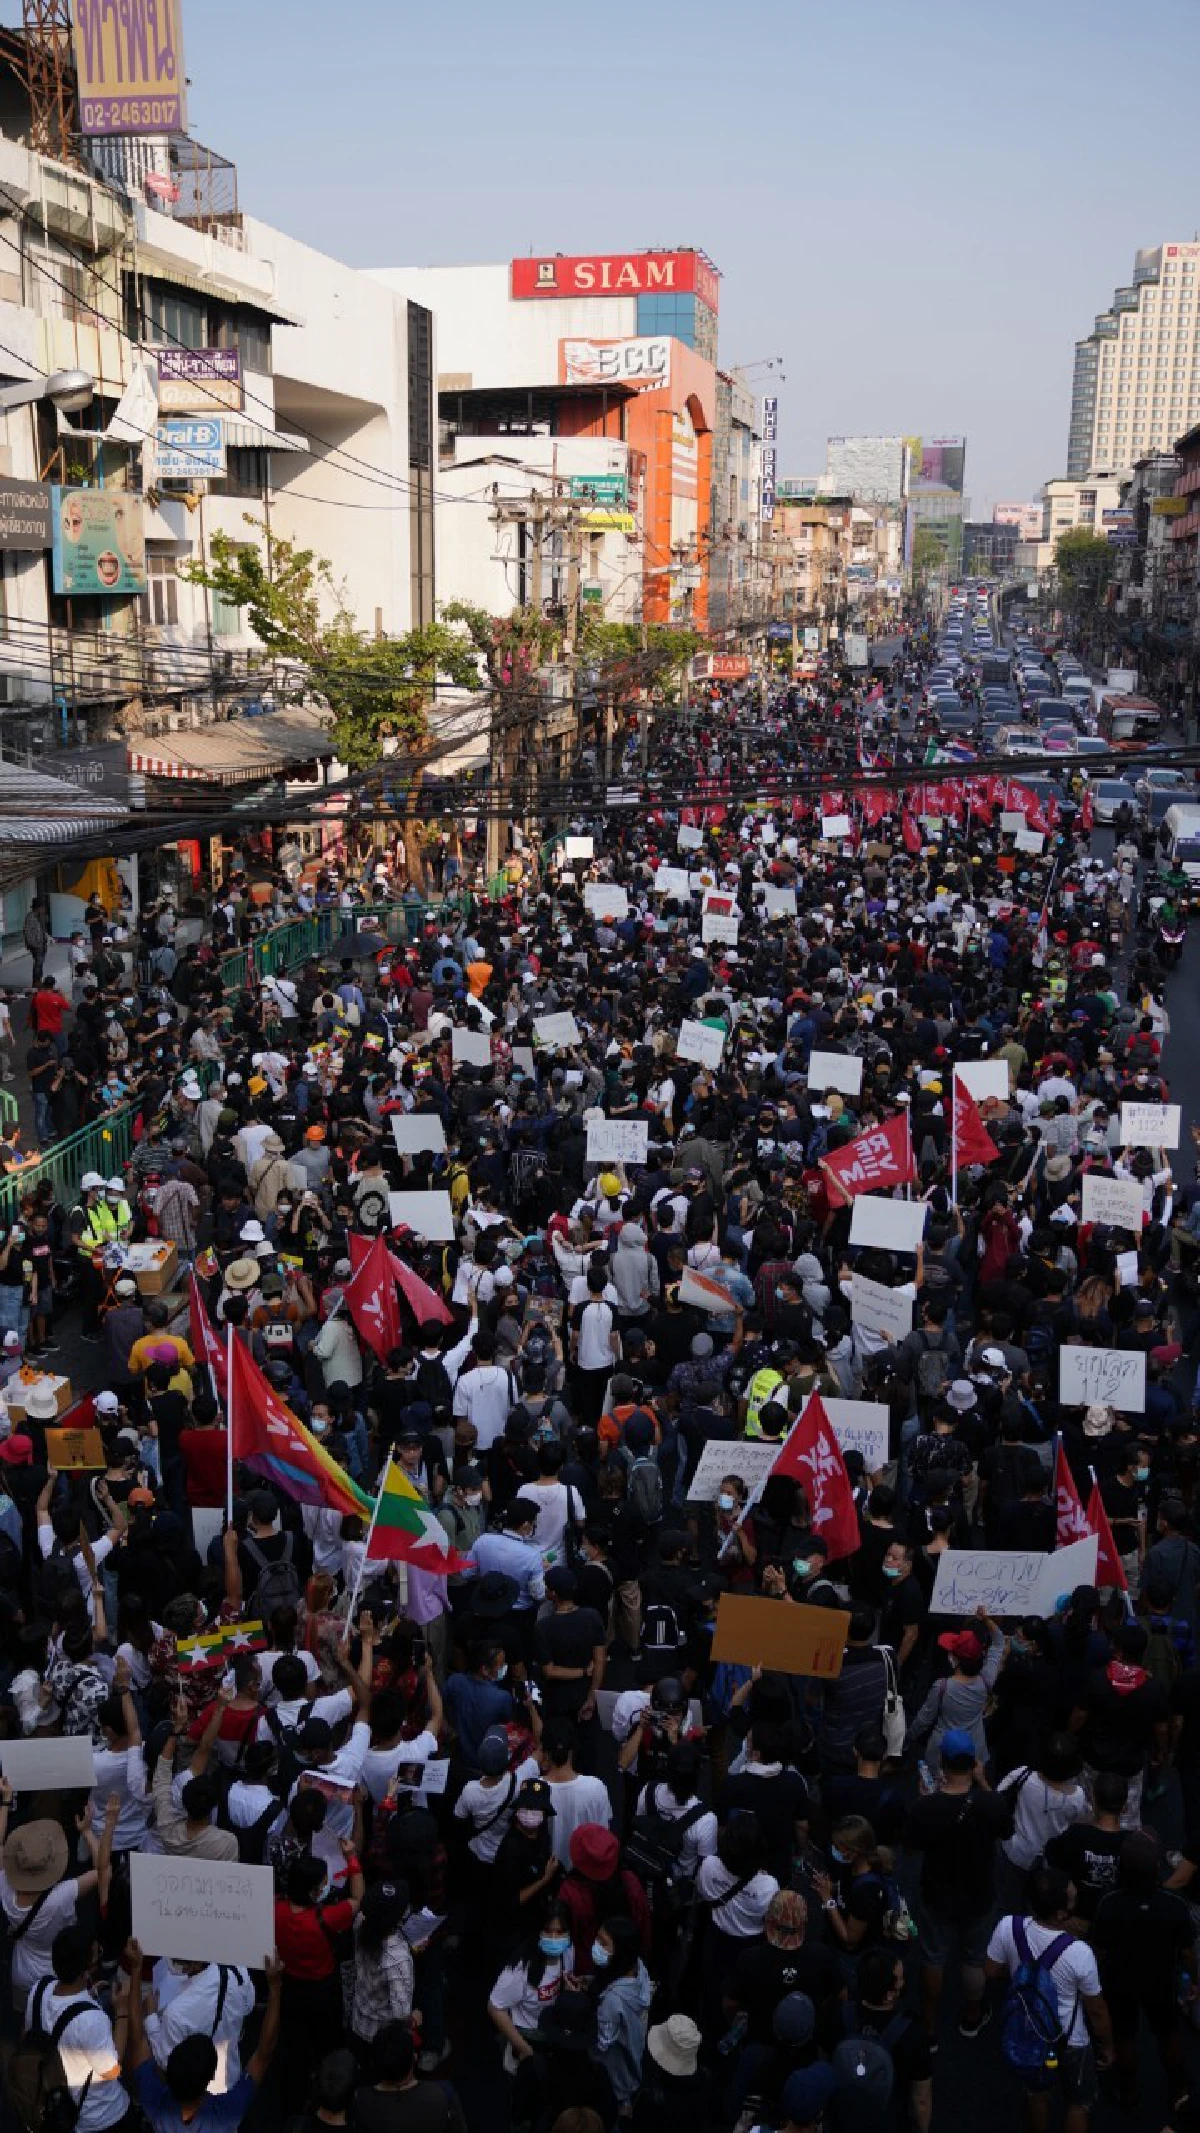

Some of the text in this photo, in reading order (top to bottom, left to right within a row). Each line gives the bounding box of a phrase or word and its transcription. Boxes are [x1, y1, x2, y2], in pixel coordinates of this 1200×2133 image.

[85, 100, 177, 127] 02-2463017
[574, 260, 676, 289] SIAM
[763, 399, 775, 518] THE BRAIN
[713, 659, 746, 671] SIAM
[1082, 1377, 1121, 1402] 112
